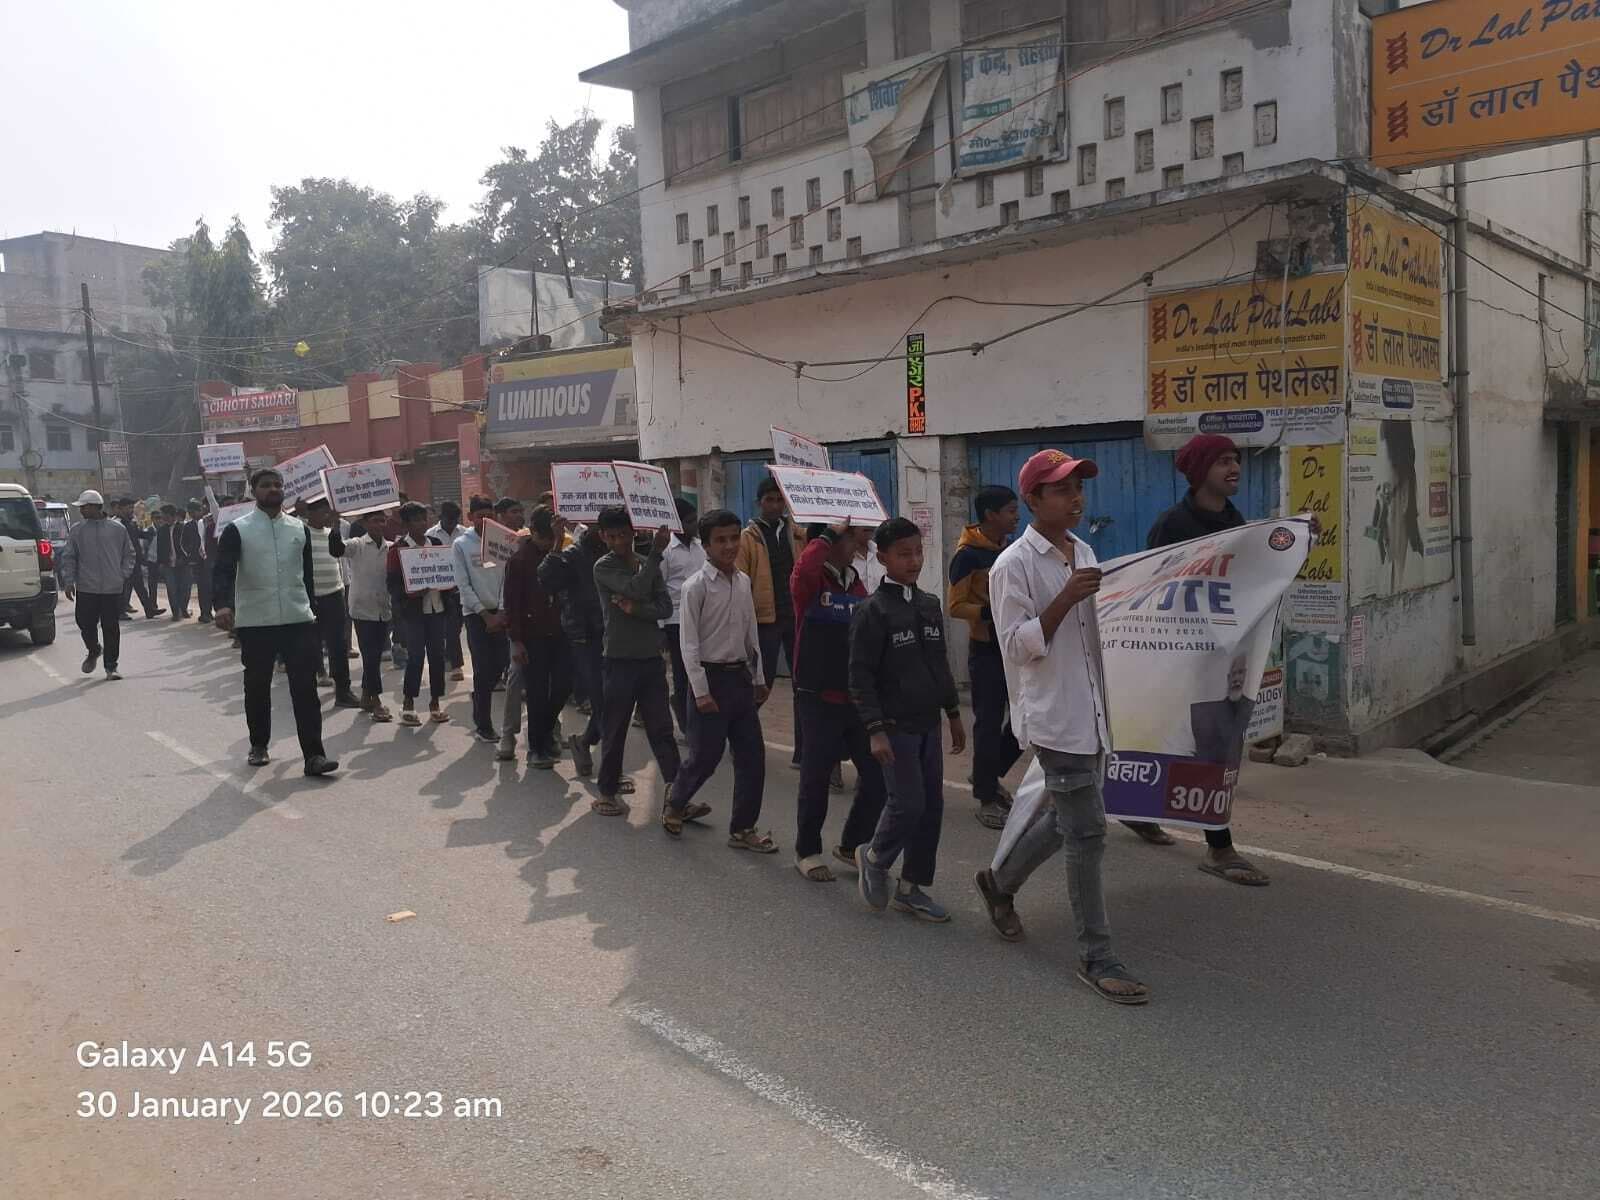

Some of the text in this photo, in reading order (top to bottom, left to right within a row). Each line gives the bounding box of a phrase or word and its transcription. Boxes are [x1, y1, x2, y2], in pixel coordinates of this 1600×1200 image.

[1420, 27, 1463, 60] Dr
[1467, 7, 1533, 48] Lal
[1419, 86, 1461, 127] डॉ
[1467, 78, 1544, 119] लाल
[1363, 222, 1378, 270] Dr
[1171, 303, 1199, 339] Dr
[1202, 297, 1241, 335] Lal
[1364, 311, 1379, 363] डॉ
[1380, 326, 1405, 367] लाल
[1171, 365, 1198, 404] डॉ
[1201, 371, 1249, 402] लाल
[1256, 355, 1340, 399] पैथलैब्स
[209, 391, 296, 413] CHHOTI SAWARI
[498, 382, 593, 421] LUMINOUS
[1302, 456, 1326, 479] Dr
[1297, 489, 1330, 513] Lal
[1295, 557, 1333, 581] Labs
[892, 629, 915, 645] FILA
[1120, 639, 1217, 651] CHANDIGARH
[1255, 686, 1283, 705] OLOGY
